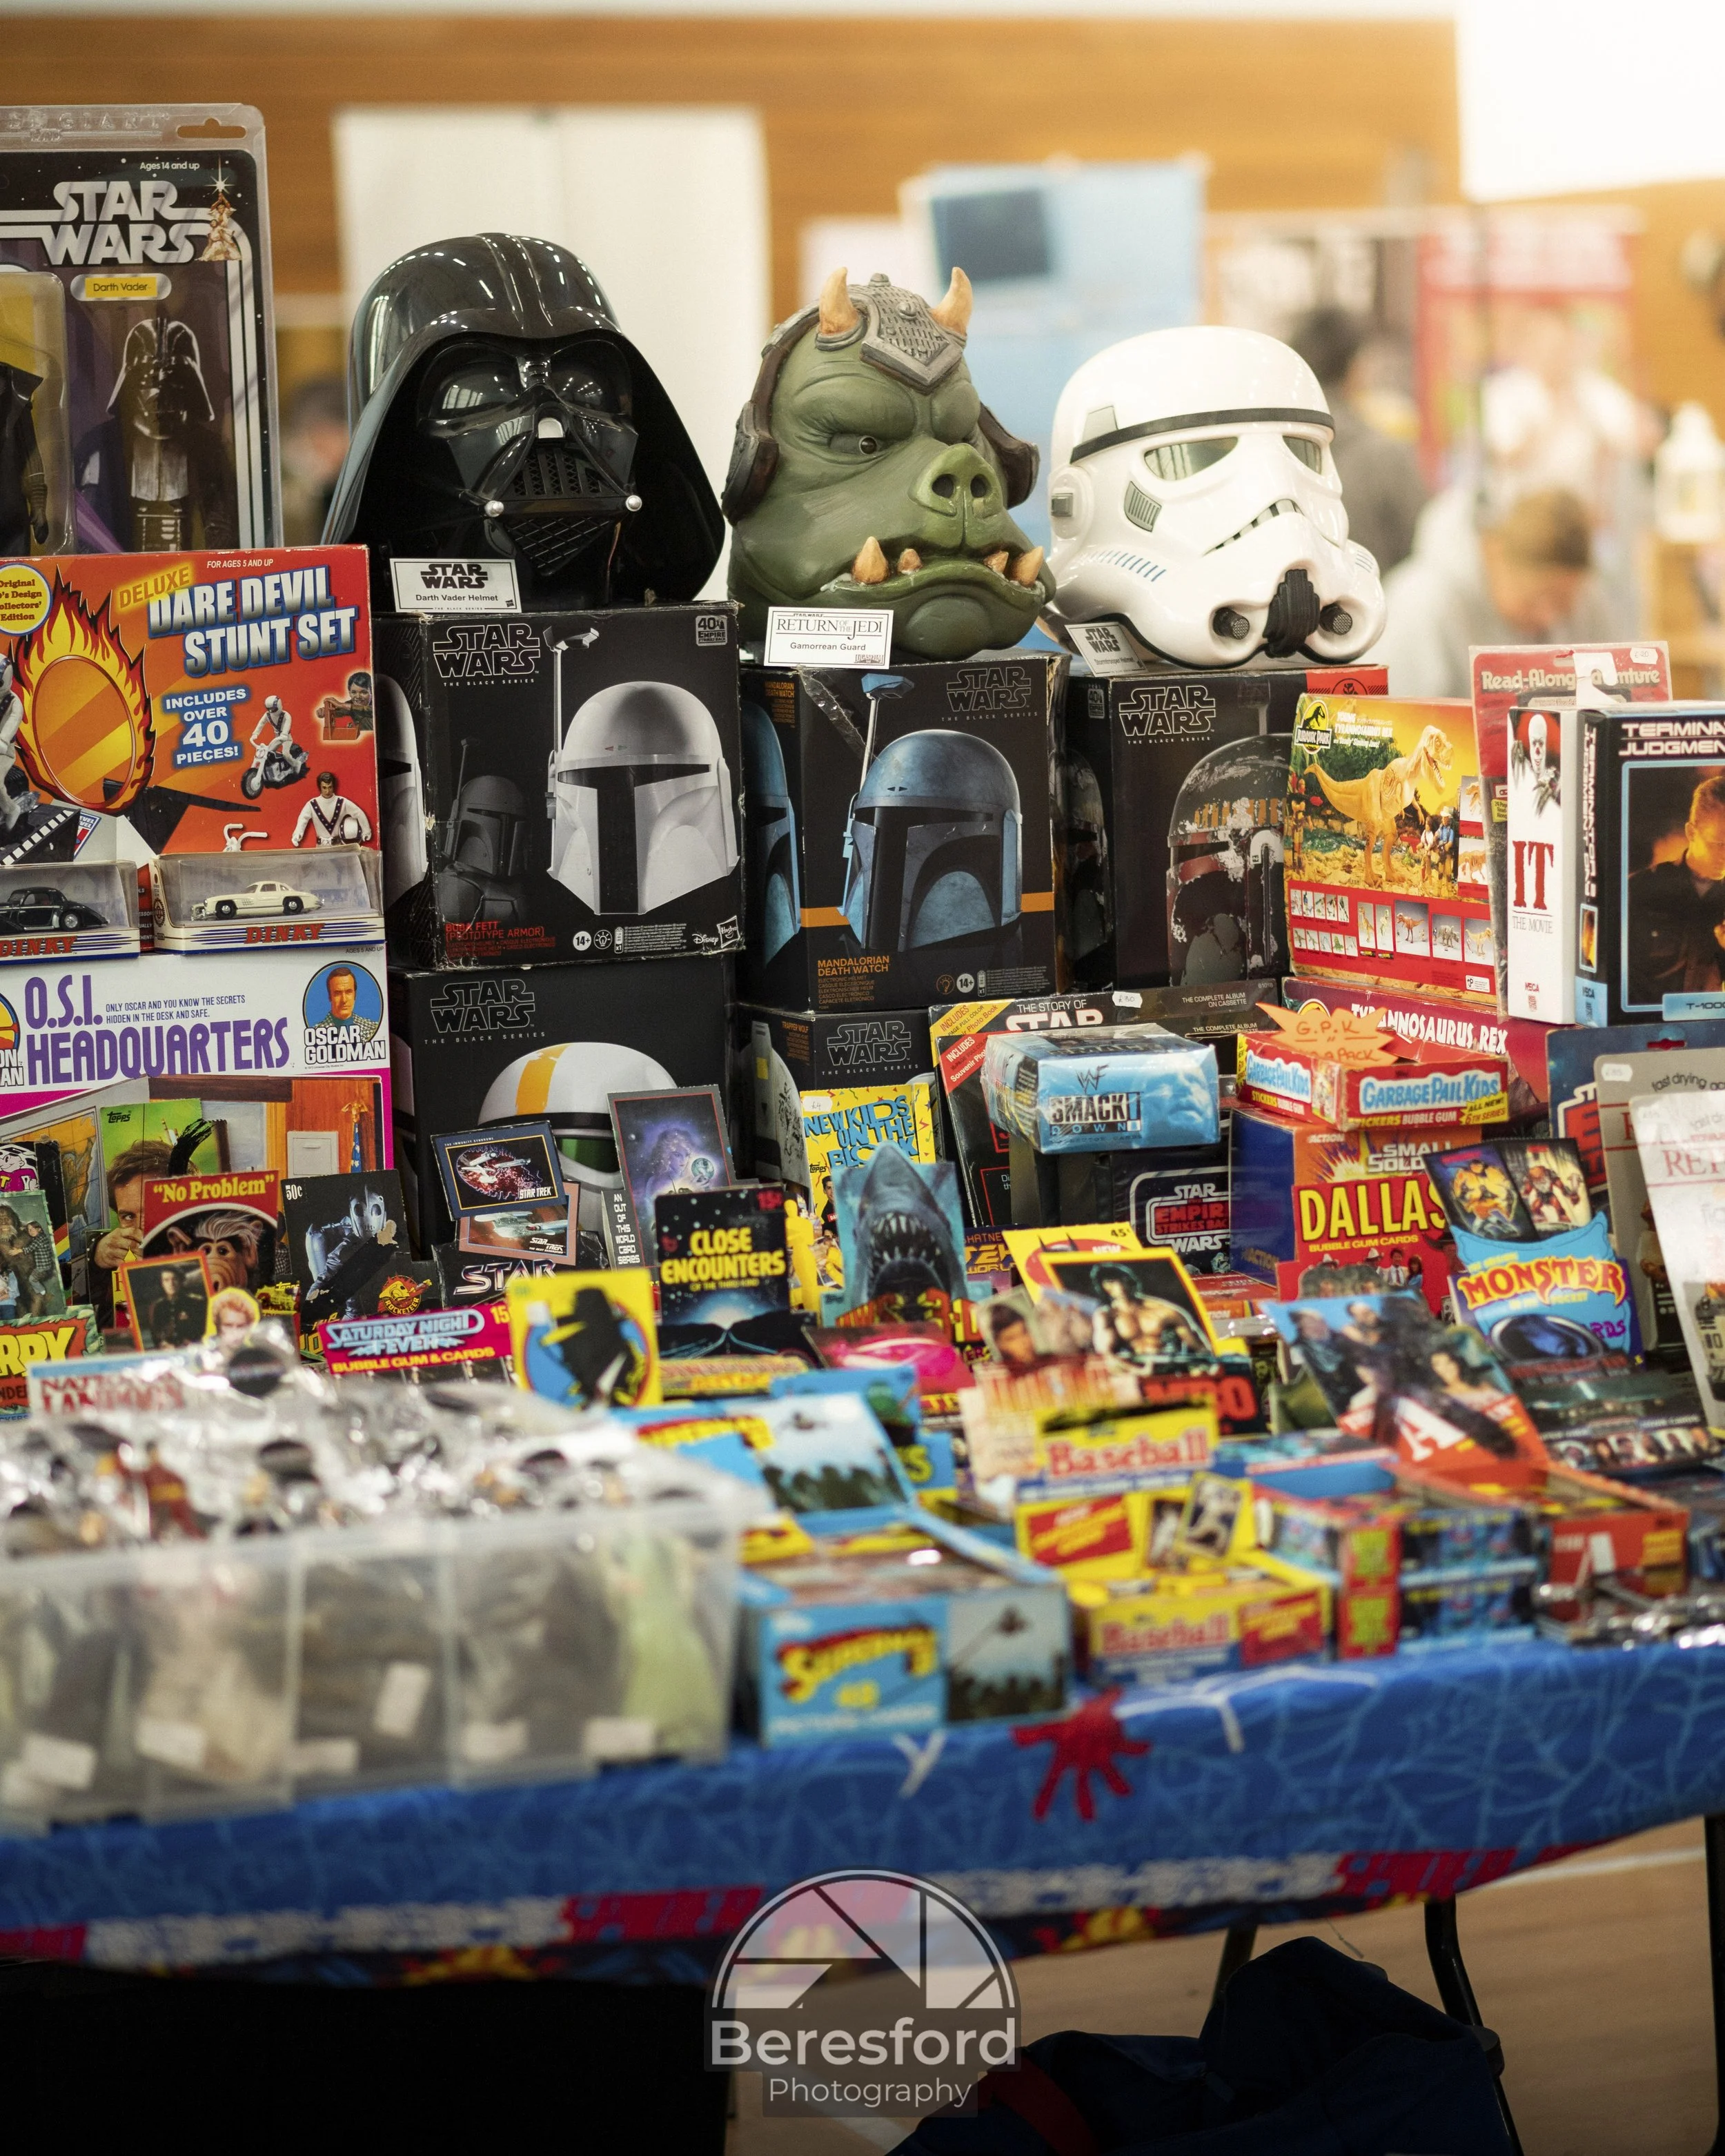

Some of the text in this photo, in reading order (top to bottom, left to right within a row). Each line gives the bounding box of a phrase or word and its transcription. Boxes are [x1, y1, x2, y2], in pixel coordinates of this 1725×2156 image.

[140, 162, 160, 170] Ages
[53, 181, 178, 221] STAR
[41, 223, 195, 265] WARS
[93, 283, 148, 292] Darth Vader
[207, 560, 221, 568] FOR
[222, 560, 241, 568] AGES
[248, 559, 263, 567] AND
[264, 558, 273, 566] UP
[420, 564, 488, 576] STAR
[119, 566, 190, 609] DELUXE
[422, 577, 489, 589] WARS
[11, 591, 42, 599] Design
[149, 567, 332, 634] DARE DEVIL
[433, 623, 540, 651] STAR
[776, 618, 838, 632] RETURN
[847, 620, 883, 640] JEDI
[1085, 628, 1115, 640] STAR
[185, 607, 355, 675] STUNT SET
[790, 642, 837, 651] Gamorrean
[1089, 639, 1121, 653] WARS
[433, 649, 540, 678] WARS
[947, 666, 1031, 691] STAR
[1481, 668, 1576, 690] Read-Along
[166, 689, 246, 709] INCLUDES
[947, 687, 1031, 712] WARS
[1119, 685, 1216, 712] STAR
[184, 706, 227, 722] OVER
[1119, 709, 1216, 737] WARS
[182, 720, 228, 747] 40
[177, 746, 239, 764] PIECES!
[1512, 840, 1555, 910] IT
[245, 922, 325, 945] DINKY
[476, 921, 498, 931] FETT
[1512, 916, 1553, 934] THE MOVIE
[0, 936, 77, 958] DINKY
[575, 936, 591, 946] 14+
[691, 933, 719, 946] Disney
[818, 956, 890, 968] MANDALORIAN
[818, 965, 889, 976] DEATH WATCH
[431, 978, 535, 1008] STAR
[958, 978, 974, 989] 14+
[25, 974, 103, 1029] O.S.I.
[106, 995, 246, 1013] ONLY OSCAR AND YOU KNOW THE SECRETS
[1016, 999, 1087, 1013] THE STORY OF
[1194, 994, 1225, 1002] COMPLETE
[1218, 998, 1247, 1007] CASSETTE
[106, 1009, 210, 1025] HIDDEN IN THE DESK AND SAFE.
[431, 1002, 535, 1033] WARS
[940, 1005, 969, 1032] INCLUDES
[983, 1005, 999, 1019] Book
[304, 1025, 362, 1047] OSCAR
[455, 1035, 492, 1043] BLACK
[503, 1031, 545, 1040] SERIES
[827, 1020, 911, 1046] STAR
[1479, 1025, 1509, 1054] REX
[27, 1017, 290, 1086] HEADQUARTERS
[304, 1040, 386, 1065] GOLDMAN
[827, 1040, 911, 1066] WARS
[946, 1036, 976, 1063] INCLUDES
[1671, 1072, 1708, 1090] drying
[1363, 1074, 1499, 1110] GARBAGE PAIL KIDS
[803, 1094, 910, 1138] NEW KIDS
[1402, 1111, 1457, 1125] BUBBLE GUM
[837, 1116, 915, 1149] ON THE
[519, 1186, 552, 1200] STAR TREK
[613, 1194, 623, 1203] AN
[1174, 1183, 1230, 1200] STAR
[614, 1203, 627, 1213] OUT
[1299, 1179, 1446, 1242] DALLAS
[617, 1214, 627, 1223] OF
[1155, 1220, 1205, 1234] STRIKES
[615, 1234, 635, 1244] WORLD
[616, 1224, 631, 1234] THIS
[618, 1244, 636, 1254] CARD
[690, 1226, 752, 1256] CLOSE
[1170, 1234, 1231, 1254] WARS
[1309, 1234, 1419, 1253] BUBBLE GUM CARDS
[618, 1254, 640, 1265] SERIES
[660, 1249, 786, 1285] ENCOUNTERS
[1457, 1256, 1626, 1309] MONSTER
[384, 1296, 420, 1316] ROCKETEER
[326, 1319, 415, 1349] SATURDAY
[420, 1311, 471, 1336] NIGHT
[373, 1335, 438, 1356] FEVER
[332, 1346, 496, 1374] BUBBLE GUM CARDS
[1050, 1426, 1208, 1478] Baseball
